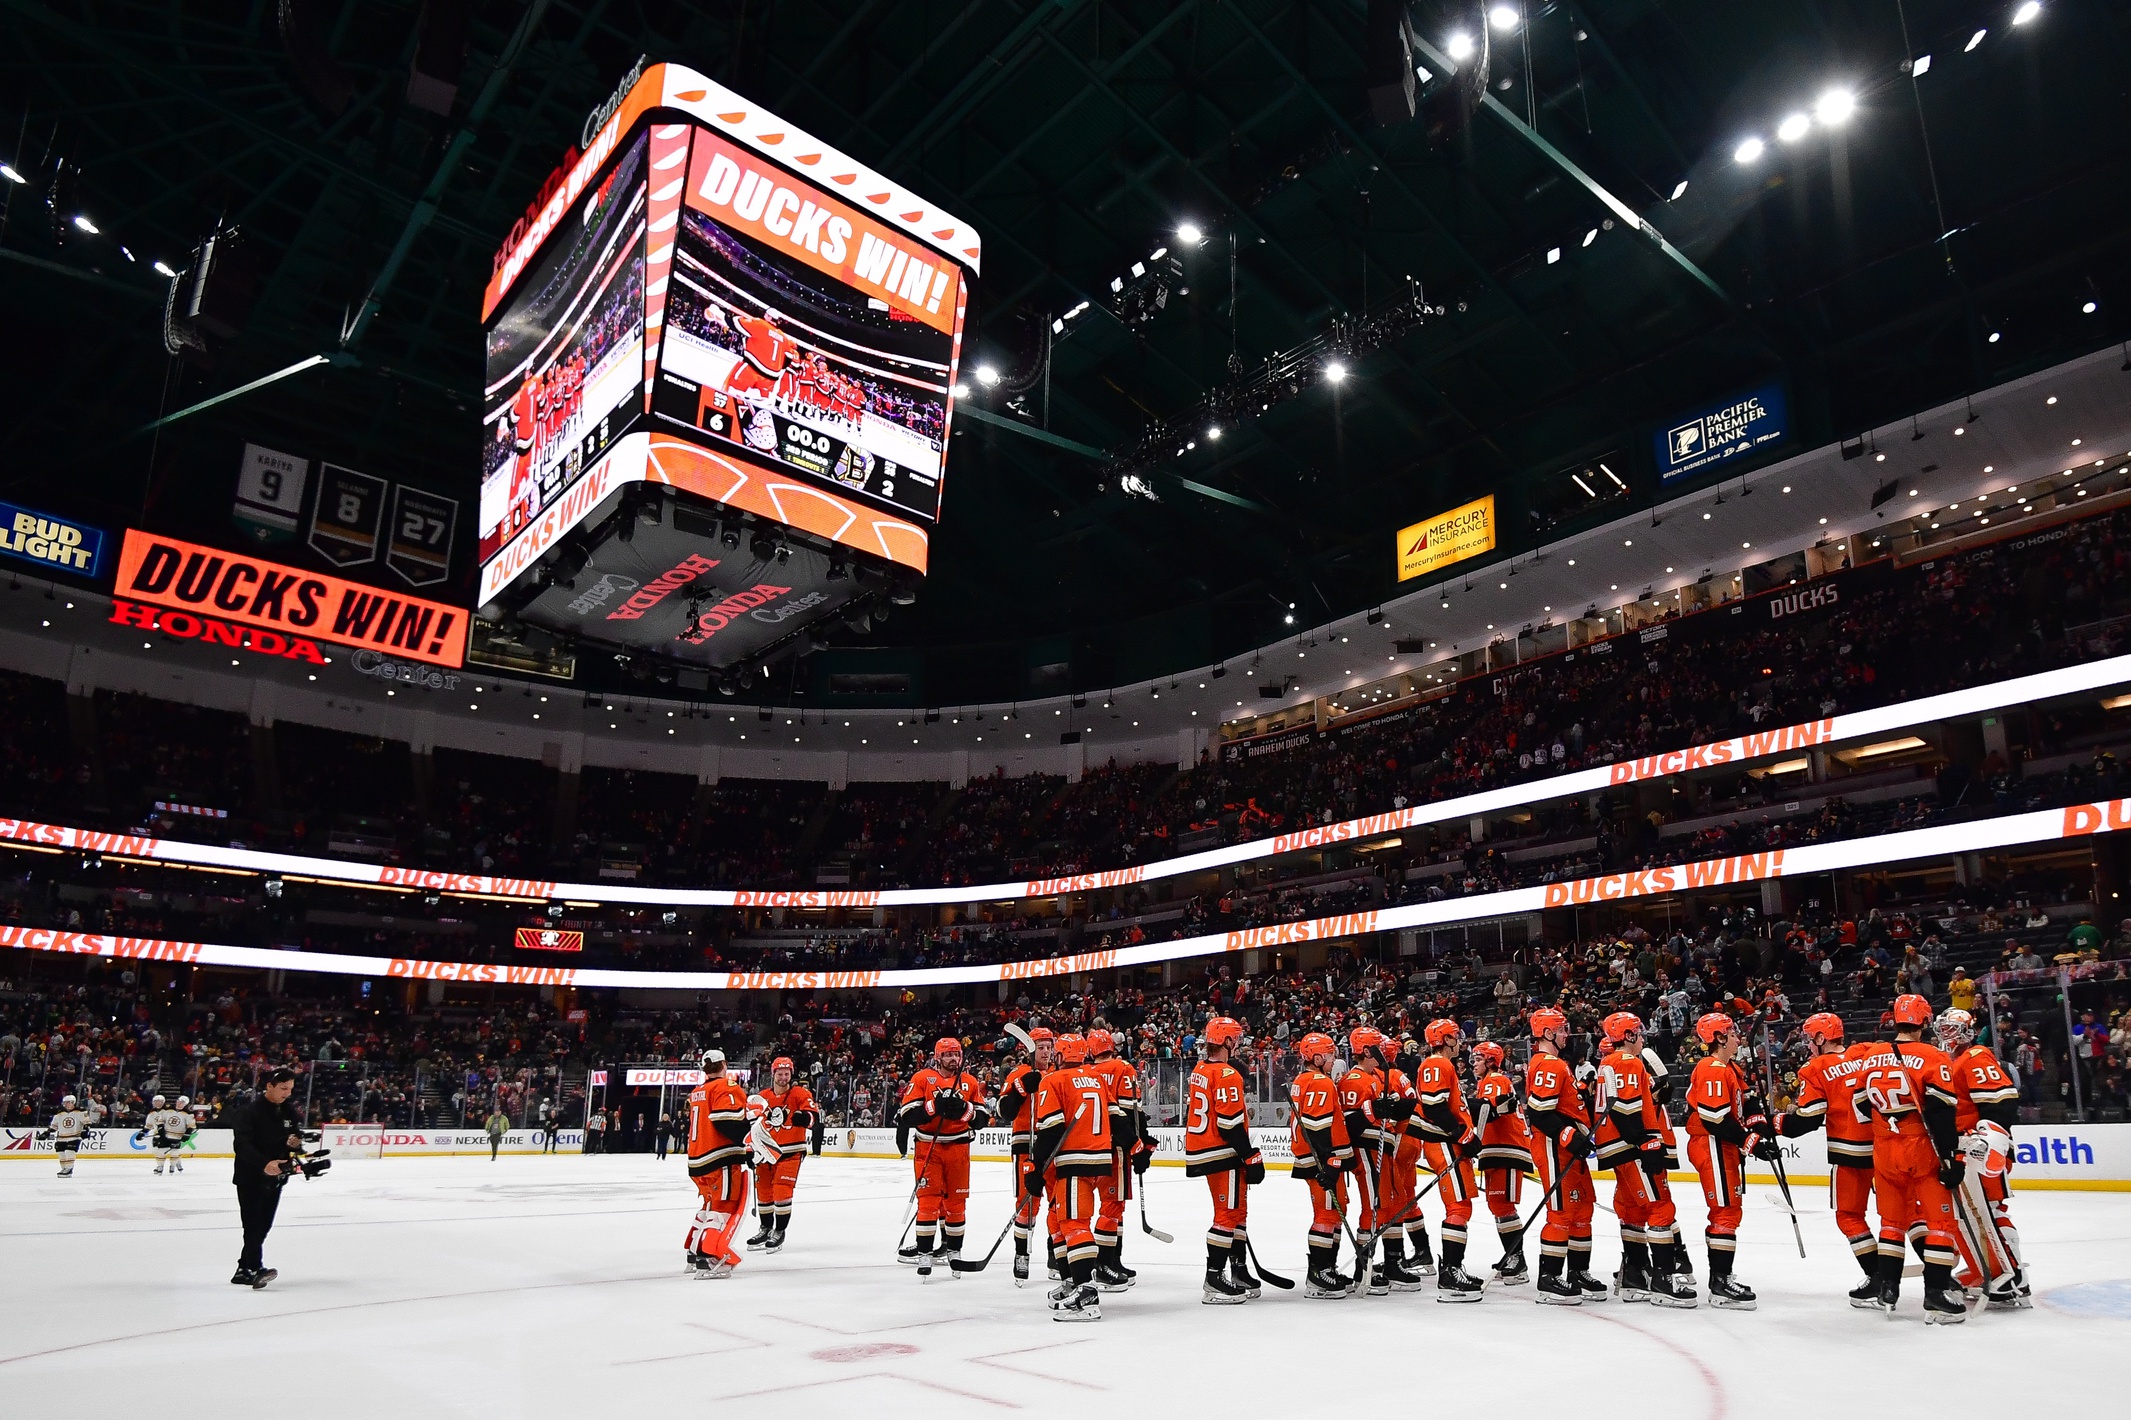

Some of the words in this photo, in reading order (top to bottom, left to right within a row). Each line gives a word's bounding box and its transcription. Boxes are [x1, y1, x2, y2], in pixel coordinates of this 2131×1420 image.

[582, 53, 646, 150] Center
[499, 187, 567, 295] DUCKS
[566, 111, 621, 204] WIN!
[699, 152, 852, 265] DUCKS
[852, 231, 951, 314] WIN!
[709, 413, 724, 431] 6
[1706, 397, 1758, 426] PACIFIC
[1707, 407, 1767, 437] PREMIER
[787, 425, 831, 454] 00.0
[258, 454, 292, 472] KARIYA
[258, 469, 282, 501] 9
[881, 480, 895, 498] 2
[337, 493, 361, 523] 8
[1429, 507, 1487, 537] MERCURY
[13, 512, 82, 547] BUD
[402, 511, 446, 545] 27
[490, 511, 556, 591] DUCKS
[559, 458, 611, 530] WIN!
[1429, 518, 1489, 547] INSURANCE
[0, 527, 92, 569] LIGHT
[1404, 535, 1490, 571] MercuryInsurance.com
[131, 543, 325, 628] DUCKS
[332, 588, 454, 655] WIN!
[606, 553, 721, 620] HONDA
[1770, 583, 1839, 619] DUCKS
[751, 591, 829, 623] Center
[109, 601, 328, 665] HONDA
[351, 648, 460, 691] Center
[1381, 713, 1404, 725] HONDA
[1248, 741, 1286, 757] ANAHEIM
[1285, 734, 1310, 749] DUCKS
[1610, 740, 1734, 786] DUCKS
[1741, 718, 1833, 760] WIN!
[74, 829, 159, 857] WIN!
[1273, 821, 1351, 854] DUCKS
[1357, 807, 1414, 837] WIN!
[378, 866, 483, 895] DUCKS
[489, 877, 557, 898] WIN!
[1025, 873, 1096, 897] DUCKS
[1100, 866, 1145, 887] WIN!
[1544, 866, 1676, 908] DUCKS
[1685, 849, 1785, 888] WIN!
[733, 891, 819, 907] DUCKS
[825, 891, 880, 907] WIN!
[1226, 921, 1310, 951] DUCKS
[1316, 911, 1378, 939] WIN!
[113, 937, 203, 962] WIN!
[386, 958, 499, 983] DUCKS
[506, 966, 577, 986] WIN!
[726, 972, 818, 989] DUCKS
[825, 970, 881, 988] WIN!
[1000, 957, 1070, 980] DUCKS
[1074, 950, 1117, 972] WIN!
[634, 1072, 700, 1083] DUCKS
[961, 1082, 969, 1092] A
[1072, 1075, 1102, 1089] GUDAS
[1423, 1067, 1440, 1083] 61
[1534, 1071, 1557, 1089] 65
[1615, 1073, 1639, 1089] 64
[1705, 1080, 1722, 1097] 11
[1972, 1065, 2001, 1083] 36
[729, 1094, 735, 1105] 1
[906, 1083, 914, 1095] 7
[1039, 1090, 1048, 1106] 7
[1216, 1086, 1239, 1103] 43
[1305, 1091, 1328, 1107] 77
[1340, 1091, 1358, 1106] 19
[1484, 1083, 1502, 1096] 51
[1866, 1070, 1910, 1112] 62
[691, 1105, 699, 1142] 1
[1082, 1092, 1101, 1135] 7
[1188, 1091, 1209, 1134] 3
[336, 1134, 429, 1146] HONDA
